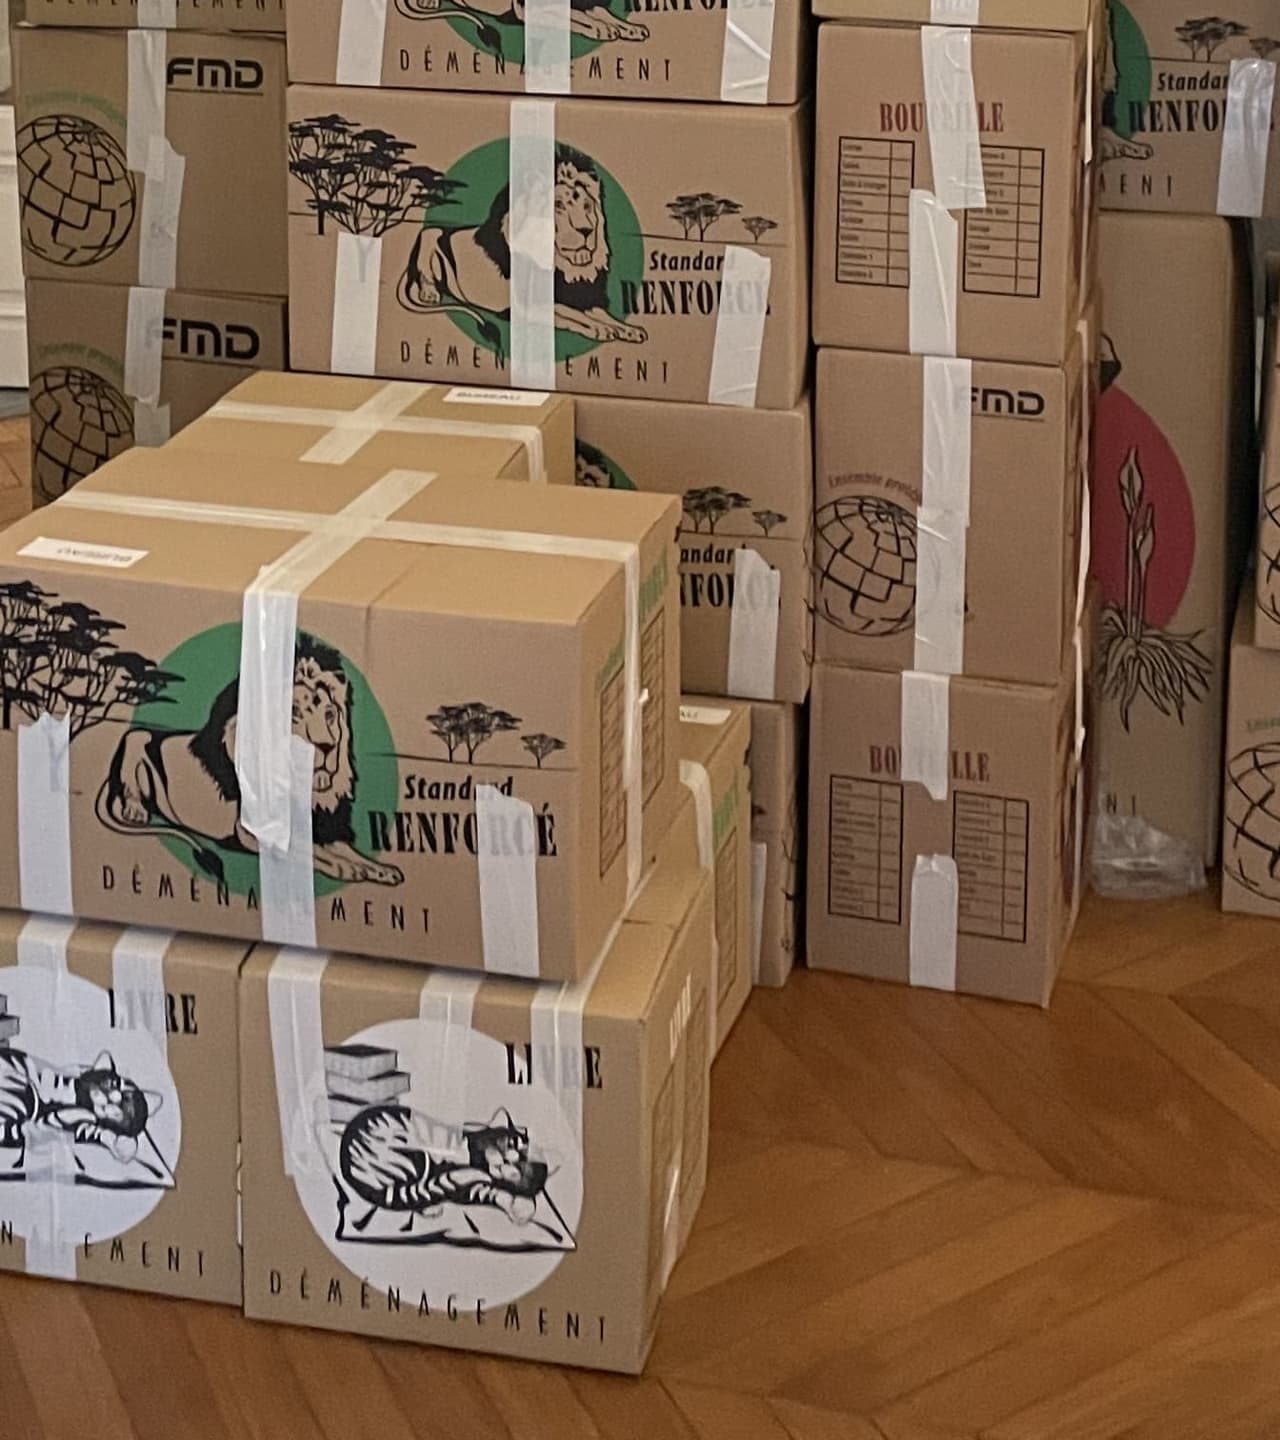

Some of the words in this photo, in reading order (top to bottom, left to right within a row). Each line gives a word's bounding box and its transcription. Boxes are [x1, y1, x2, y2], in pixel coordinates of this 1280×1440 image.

[167, 57, 263, 89] FMD
[1158, 70, 1229, 91] Standar
[880, 102, 1004, 133] BOULE
[1128, 99, 1275, 133] RENFO
[649, 250, 733, 272] Standar
[620, 279, 771, 316] RENFO
[971, 387, 1045, 416] MD
[680, 543, 746, 565] andar
[870, 745, 990, 782] BOLLE
[404, 775, 513, 801] Standd
[368, 803, 557, 856] RENFOÉ
[108, 988, 198, 1035] LRE
[505, 1040, 602, 1088] LIE
